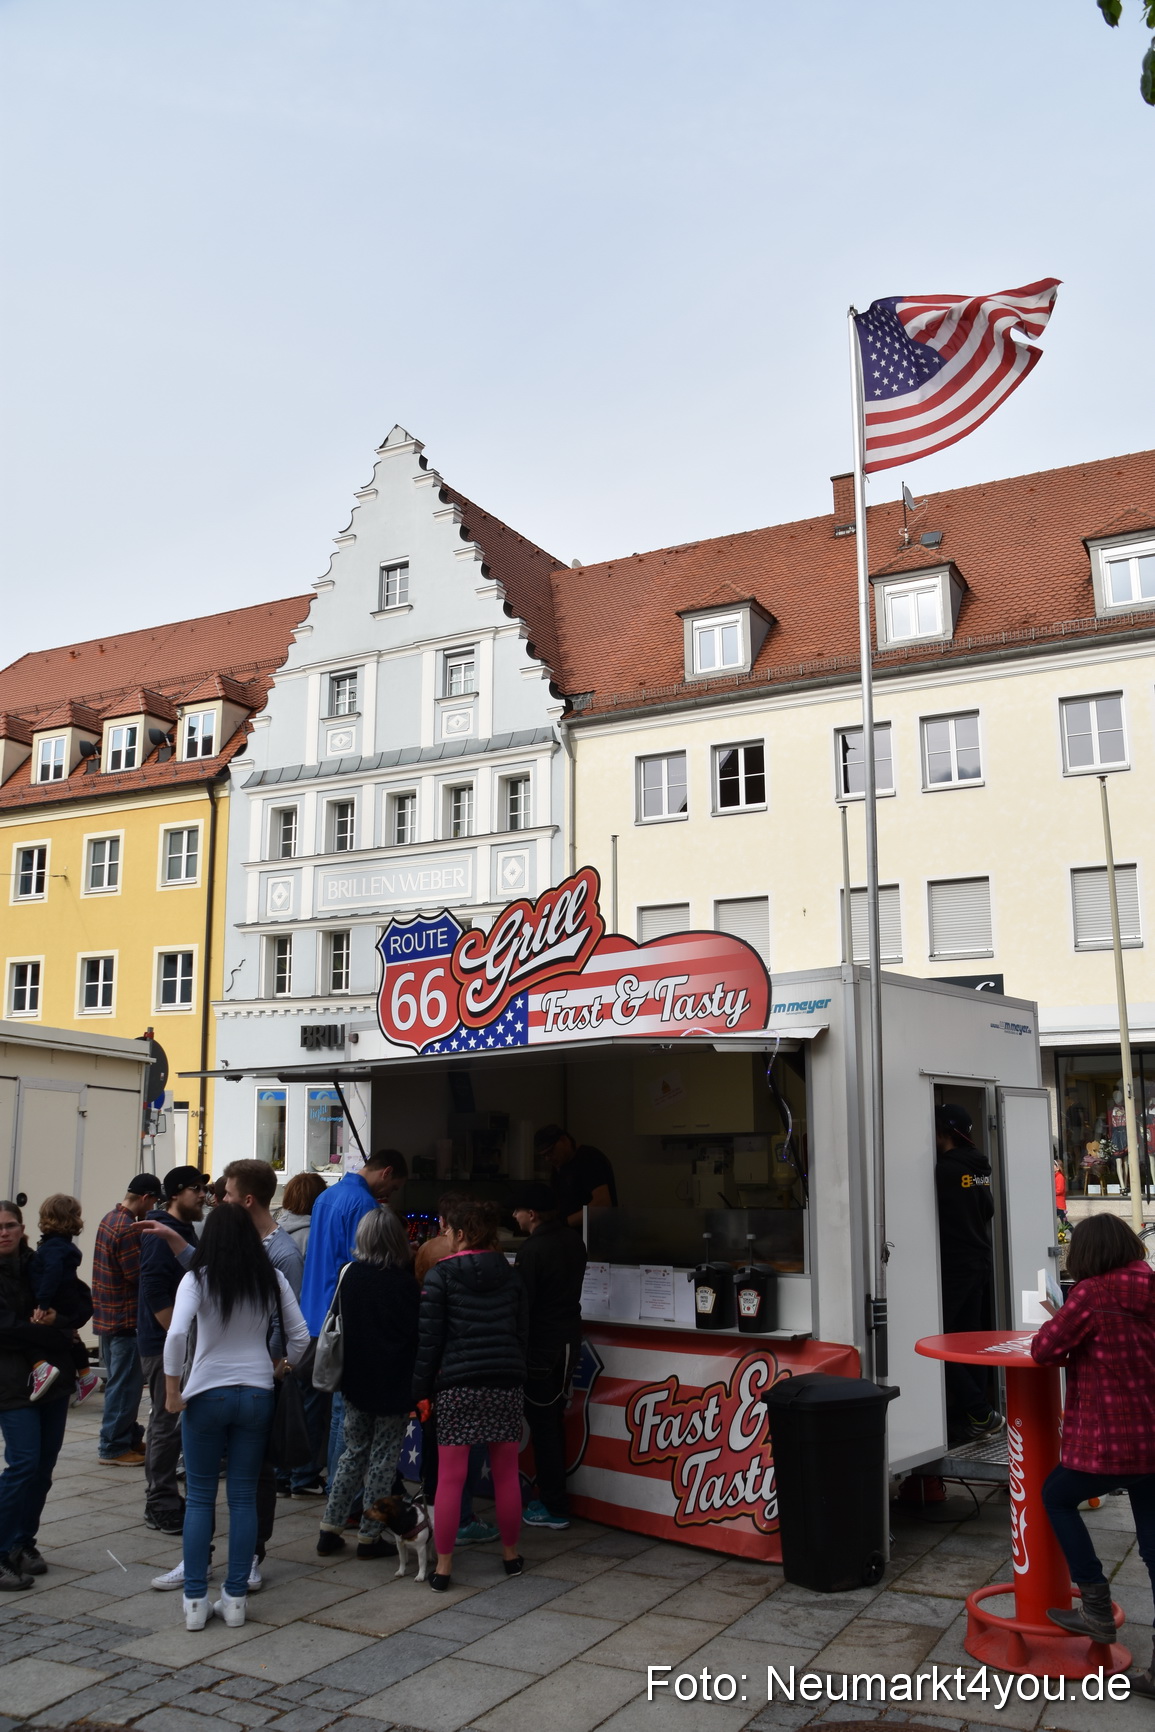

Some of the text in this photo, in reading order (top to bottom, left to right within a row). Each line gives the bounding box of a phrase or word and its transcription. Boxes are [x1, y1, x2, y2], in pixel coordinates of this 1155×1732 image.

[327, 868, 466, 900] BRILLEN WEBER
[390, 927, 449, 955] ROUTE
[458, 879, 588, 1012] Grill
[390, 967, 448, 1031] 66
[540, 973, 751, 1033] Fast & Tasty
[787, 998, 832, 1014] meyer
[634, 1360, 768, 1453] Fast &
[681, 1447, 779, 1520] Tasty
